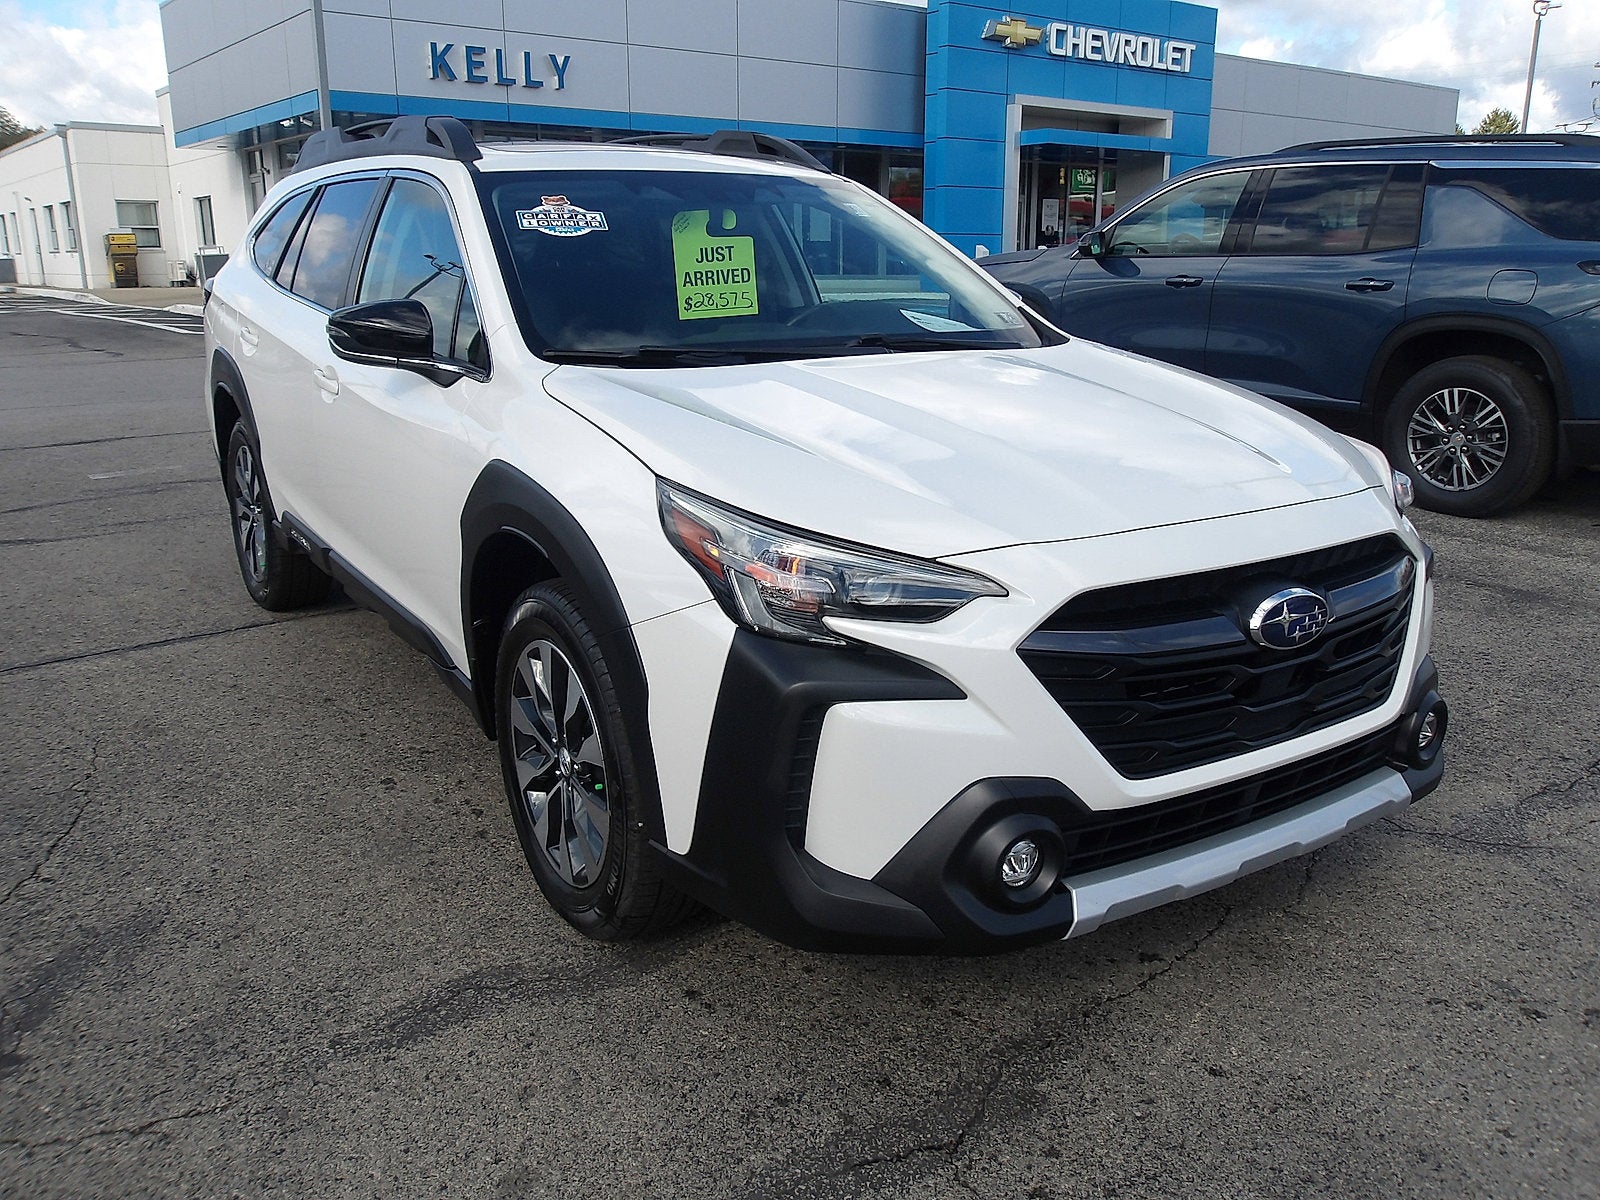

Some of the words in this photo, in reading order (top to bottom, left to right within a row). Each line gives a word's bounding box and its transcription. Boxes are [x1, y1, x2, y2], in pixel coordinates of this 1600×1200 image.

[1046, 22, 1196, 73] CHEVROLET
[428, 41, 571, 90] KELLY
[522, 212, 599, 221] CARFAX
[538, 219, 602, 228] OWNER
[695, 245, 735, 264] JUST
[682, 267, 751, 288] ARRIVED
[683, 291, 754, 312] $28,575
